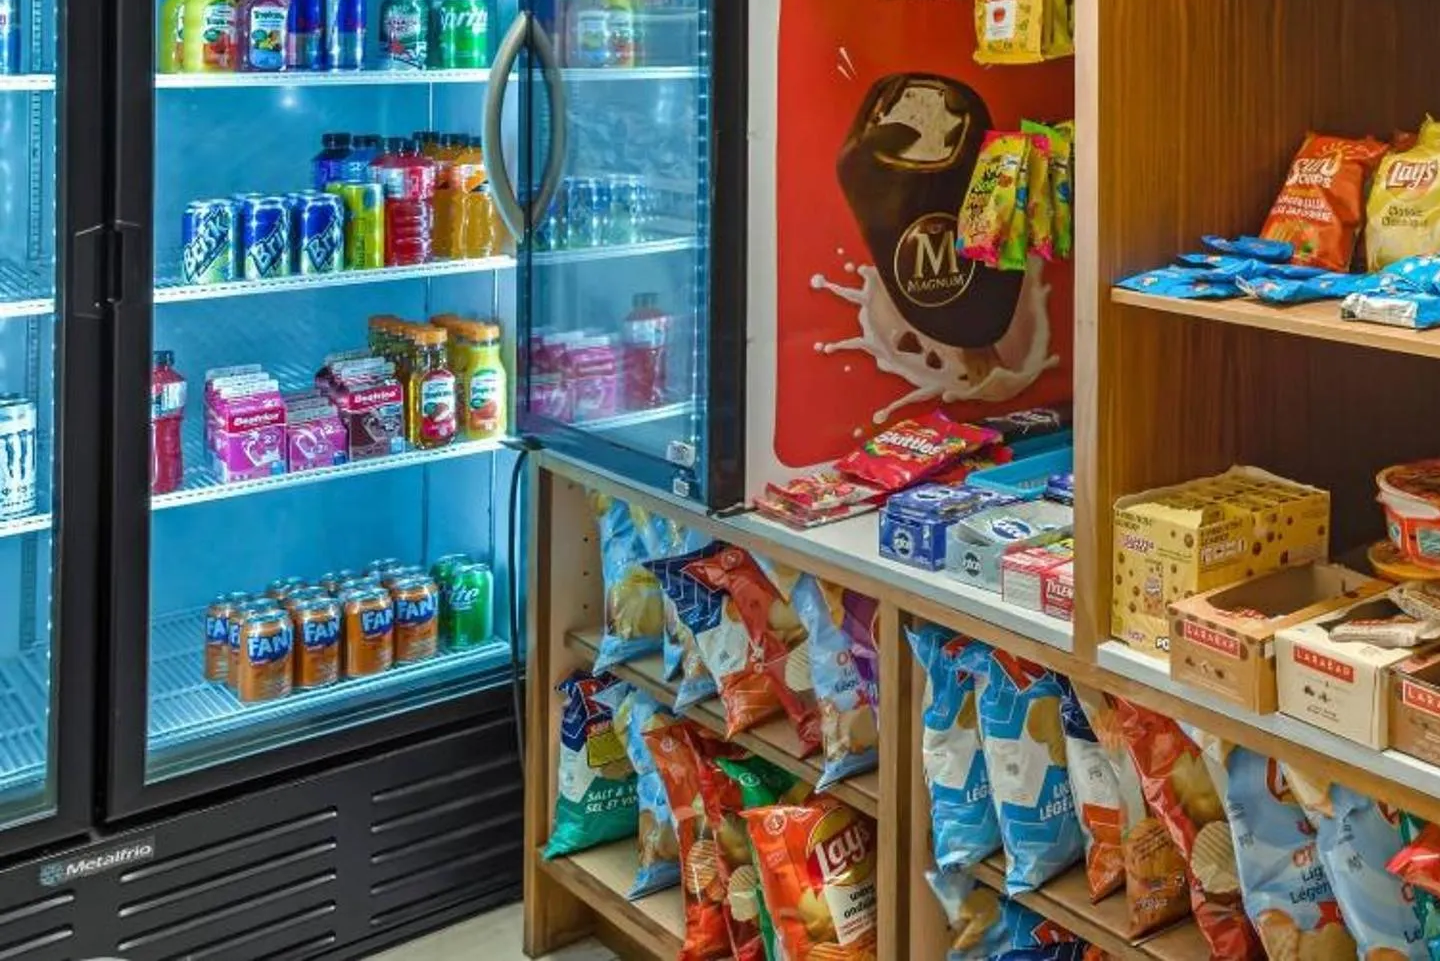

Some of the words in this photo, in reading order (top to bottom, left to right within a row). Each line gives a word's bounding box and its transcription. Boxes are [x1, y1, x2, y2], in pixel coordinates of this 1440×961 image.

[1387, 160, 1438, 189] Lay's
[906, 273, 966, 294] MAGNUM
[877, 431, 942, 456] Skittles
[1046, 577, 1073, 597] TYLEN
[1186, 623, 1237, 655] LARABAR
[1298, 646, 1351, 679] LARABAR
